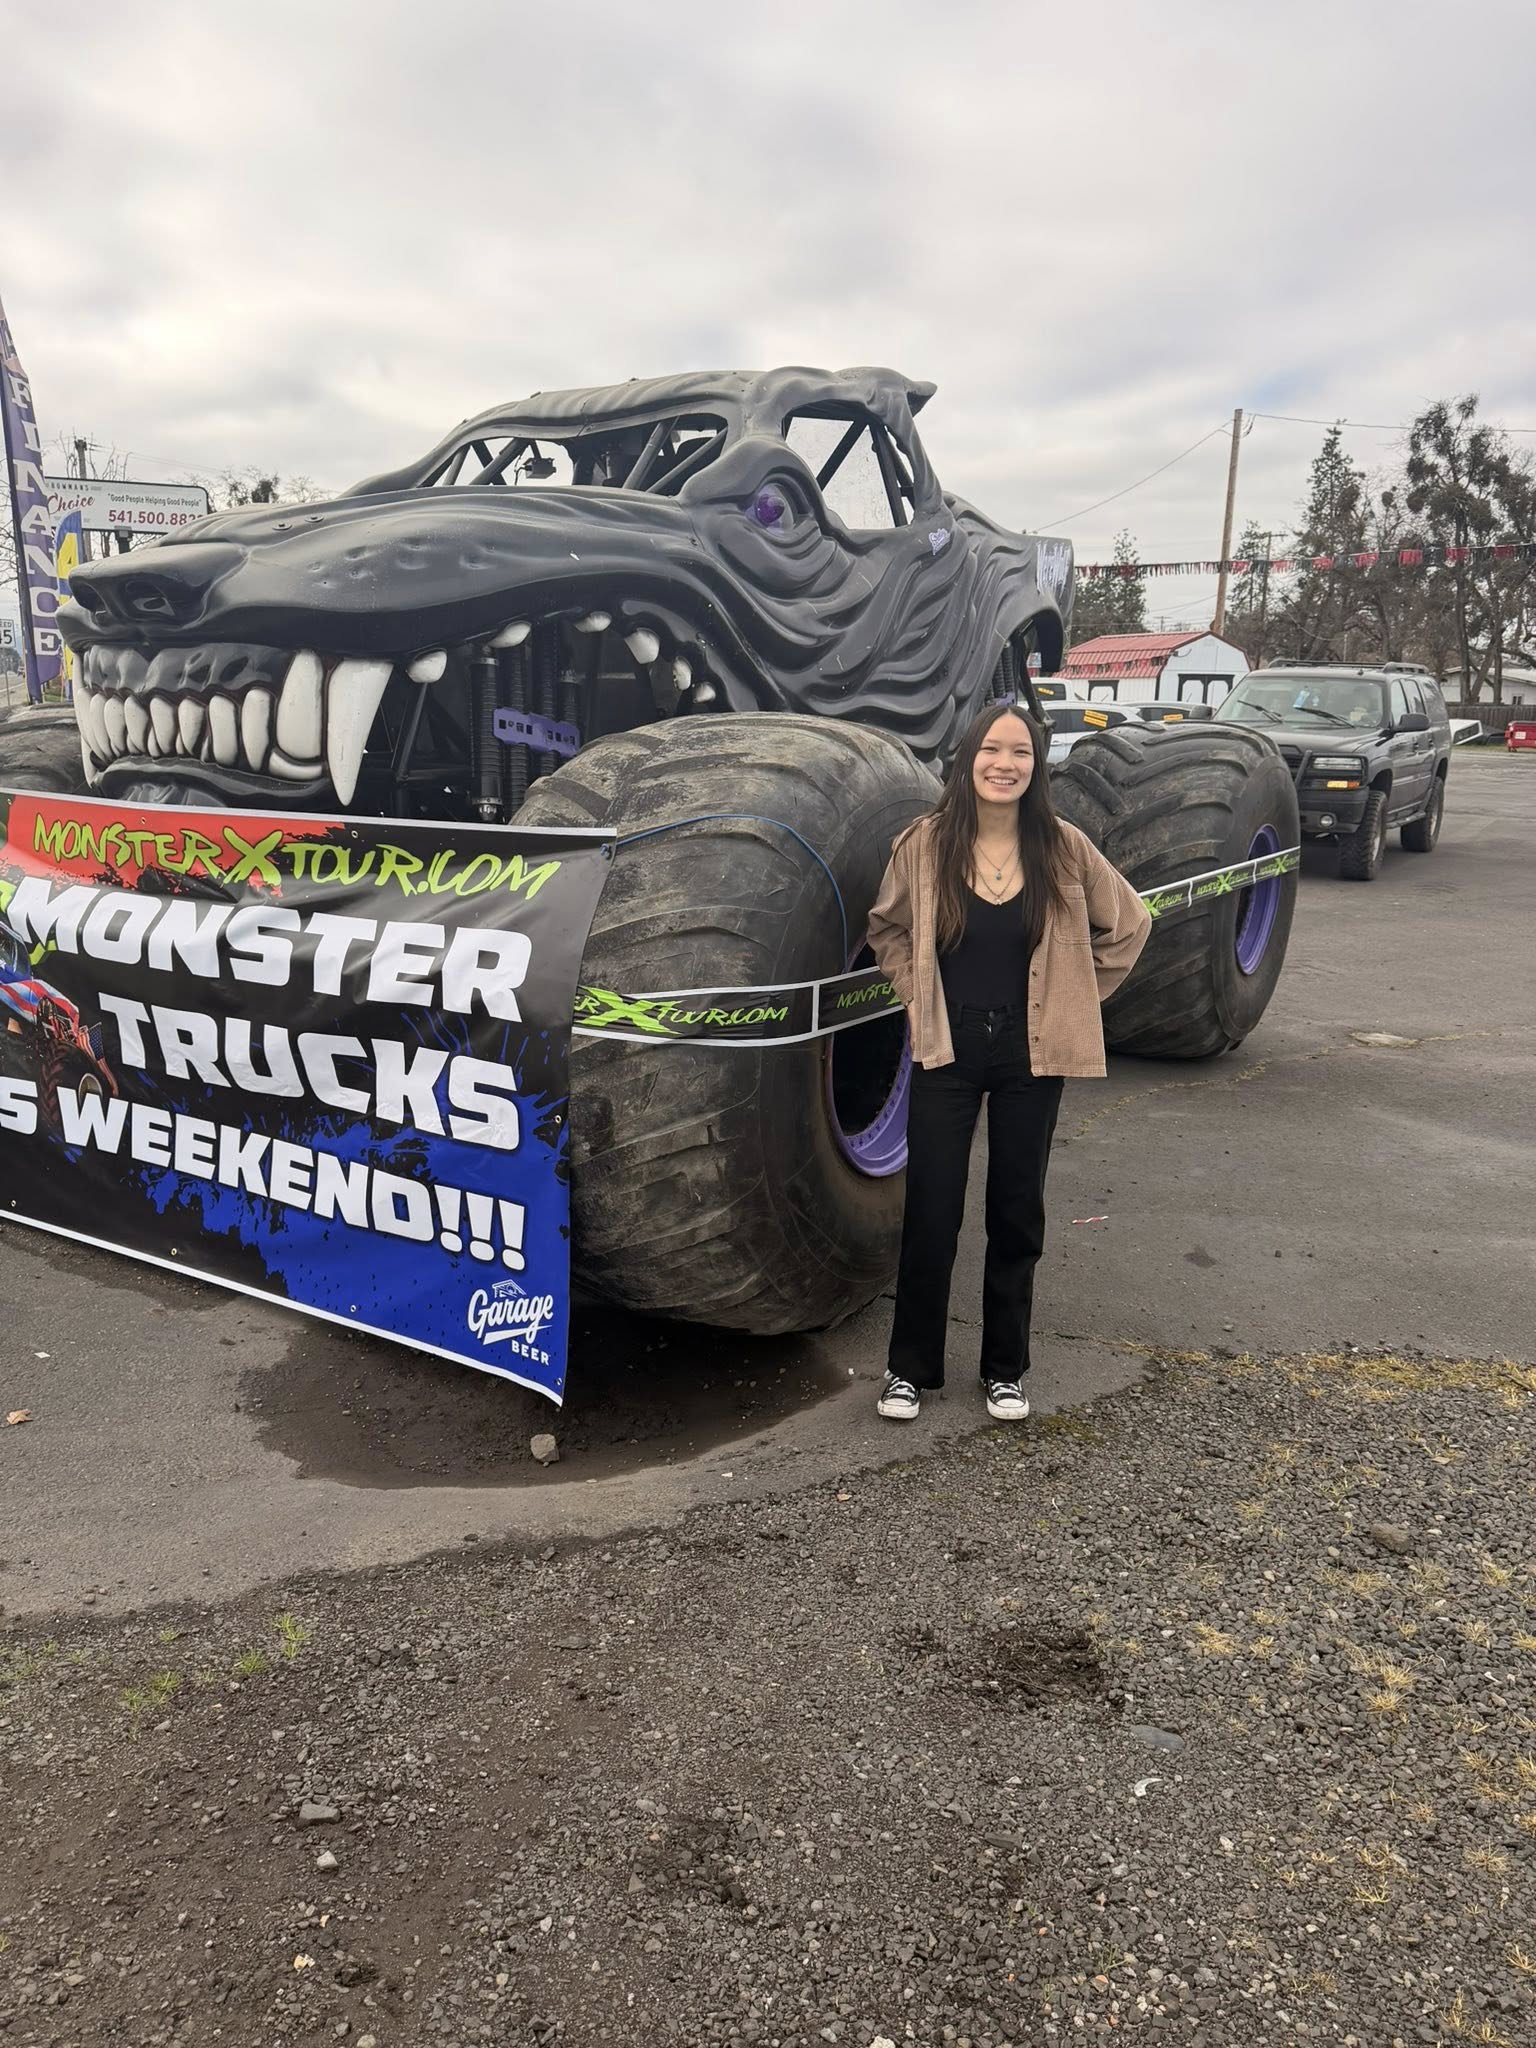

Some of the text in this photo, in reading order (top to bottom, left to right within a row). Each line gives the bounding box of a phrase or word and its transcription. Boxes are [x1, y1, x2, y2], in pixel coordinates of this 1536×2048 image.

[7, 372, 63, 657] FINANCE
[47, 493, 95, 515] Choice
[126, 495, 144, 505] People
[145, 497, 166, 506] Helping
[167, 498, 180, 506] Good
[7, 876, 532, 1023] MONSTER
[98, 992, 520, 1151] TRUCKS
[56, 1086, 526, 1271] WEEKEND!!!
[468, 1288, 554, 1344] Garage
[511, 1340, 550, 1366] BEER
